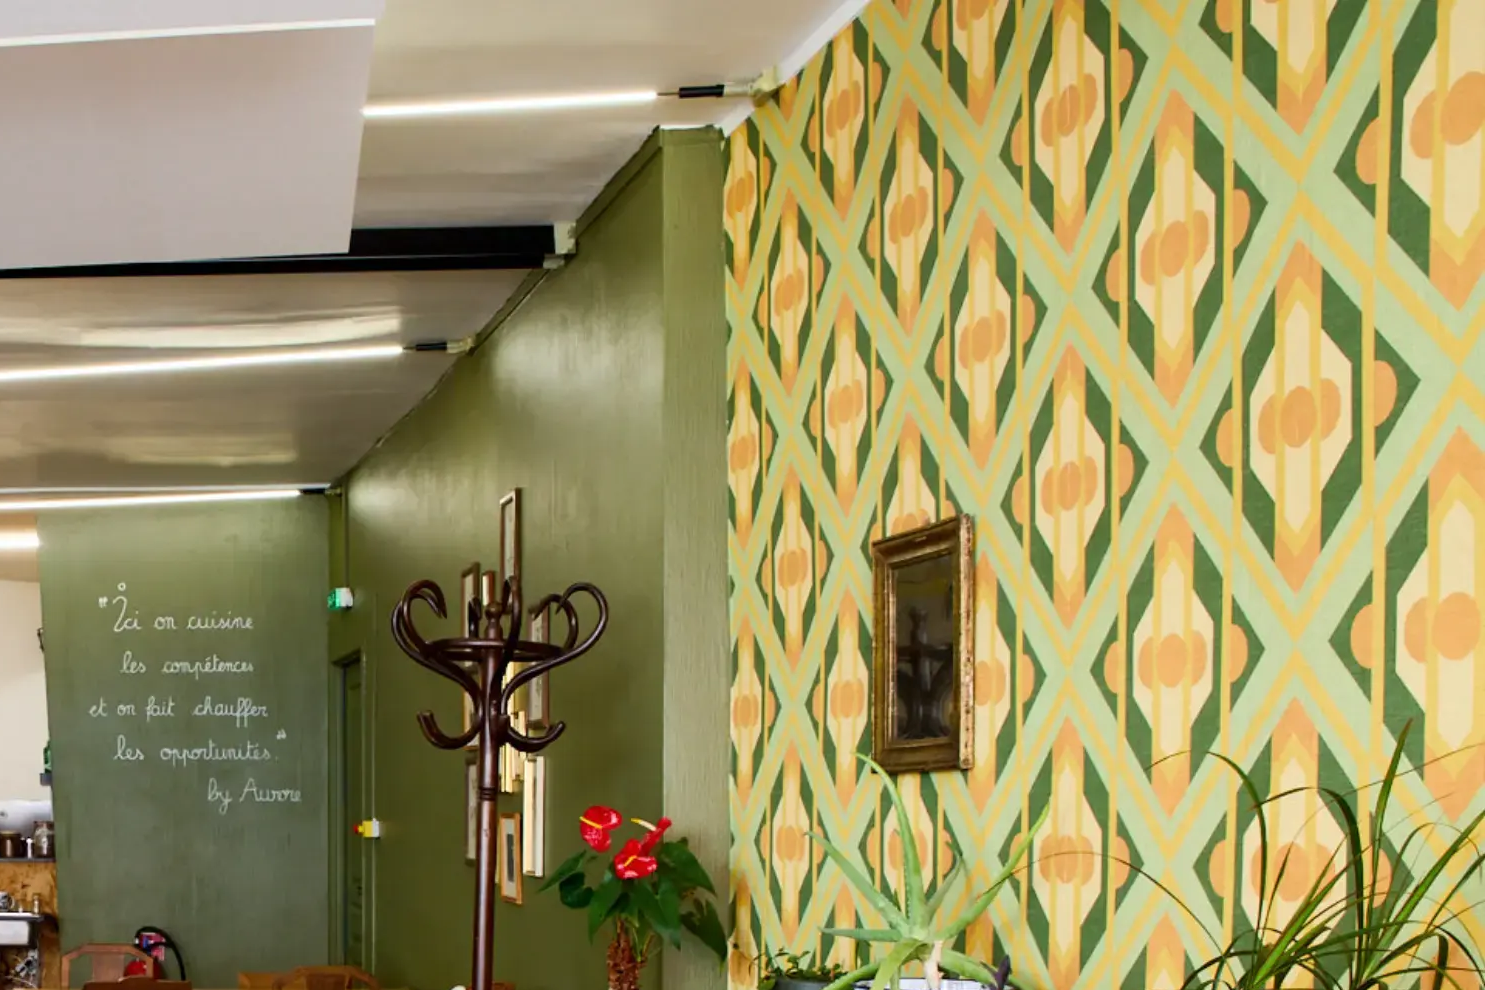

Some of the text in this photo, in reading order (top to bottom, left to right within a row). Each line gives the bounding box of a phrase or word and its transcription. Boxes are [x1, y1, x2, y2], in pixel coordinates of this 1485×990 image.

[153, 616, 177, 630] on
[185, 610, 254, 630] cuisine
[119, 650, 254, 681] les compétences
[89, 695, 269, 728] et on fait chauffer
[113, 734, 145, 761] les
[207, 777, 302, 815] by Aurore
